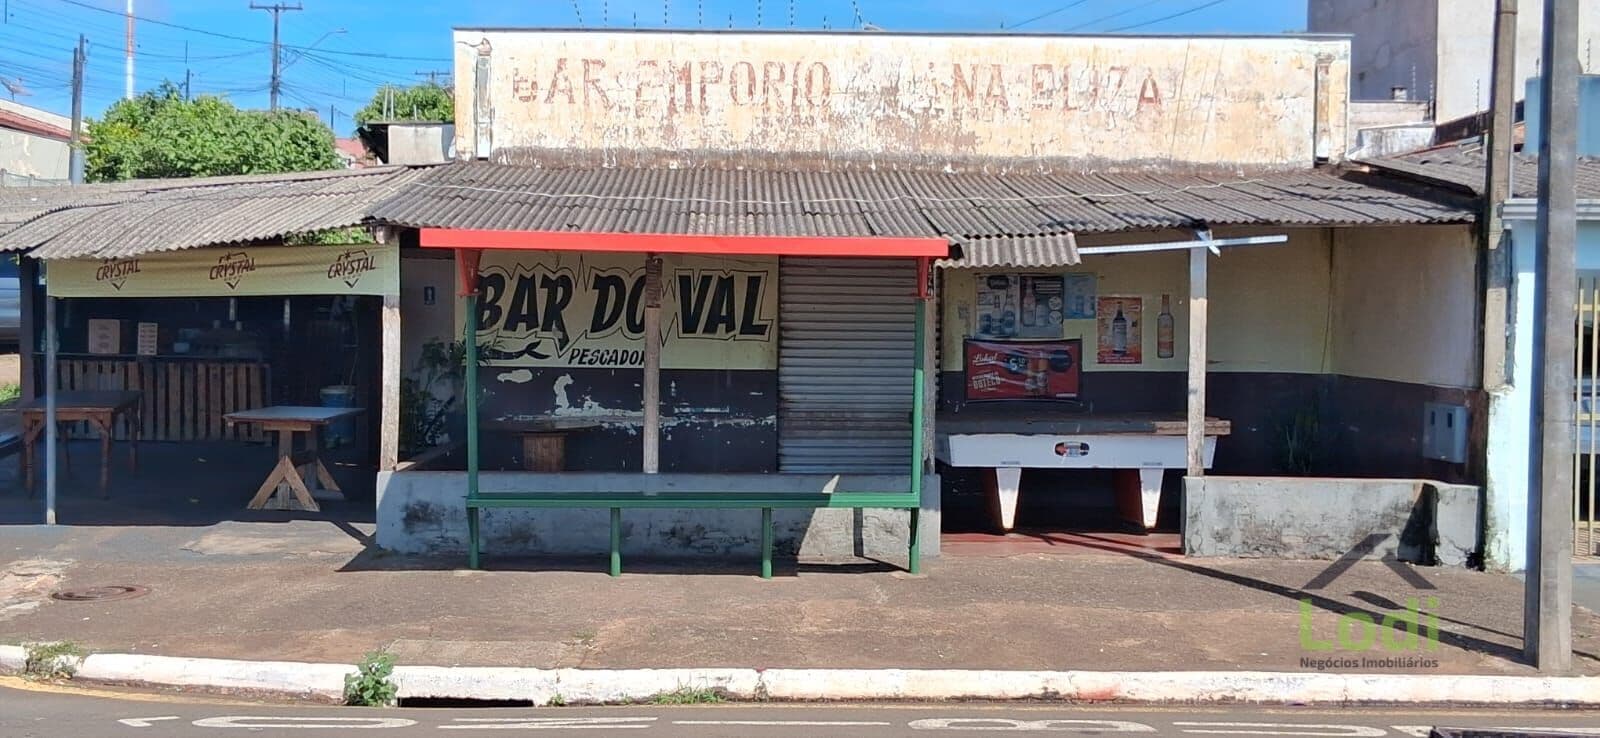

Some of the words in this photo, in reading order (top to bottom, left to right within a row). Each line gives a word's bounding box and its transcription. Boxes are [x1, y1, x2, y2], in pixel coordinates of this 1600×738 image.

[96, 259, 142, 281] CRYSTAL
[209, 257, 256, 280] CRYSTAL
[327, 255, 377, 279] CRYSTAL
[475, 273, 570, 346] BAR
[677, 274, 769, 335] VAL
